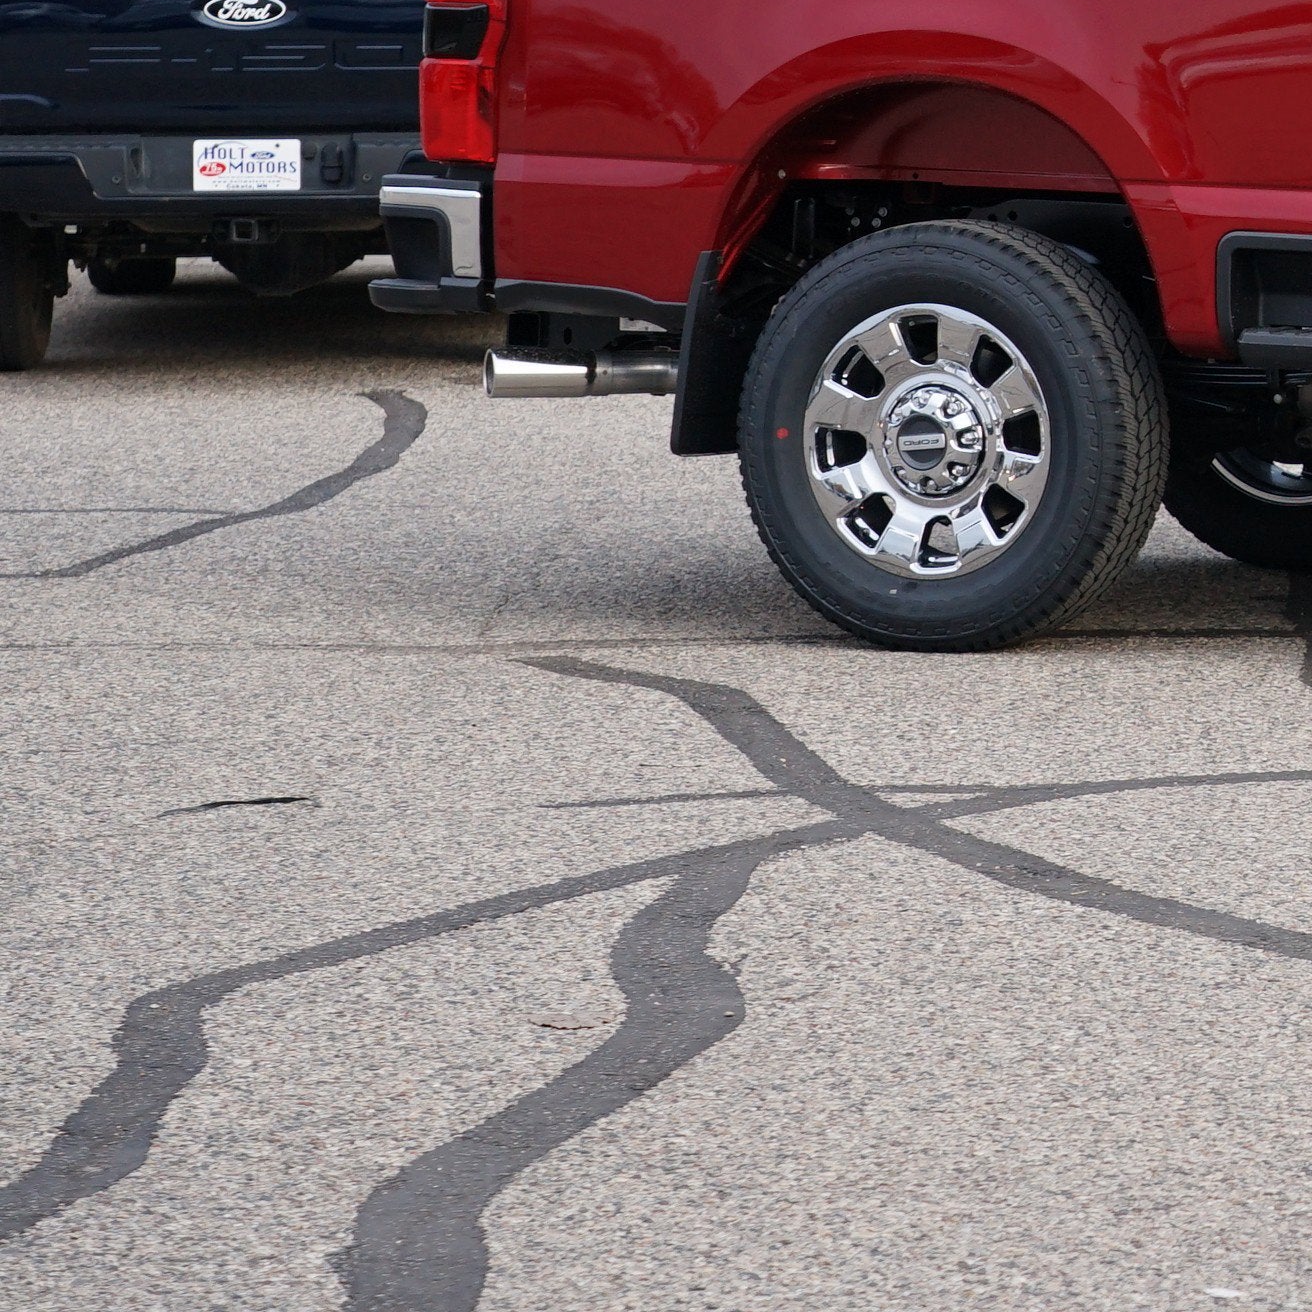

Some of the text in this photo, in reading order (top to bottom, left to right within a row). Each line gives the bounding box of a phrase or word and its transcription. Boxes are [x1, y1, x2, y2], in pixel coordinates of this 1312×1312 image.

[204, 146, 247, 160] HOLT
[229, 160, 297, 173] MOTORS
[903, 438, 940, 447] FORD
